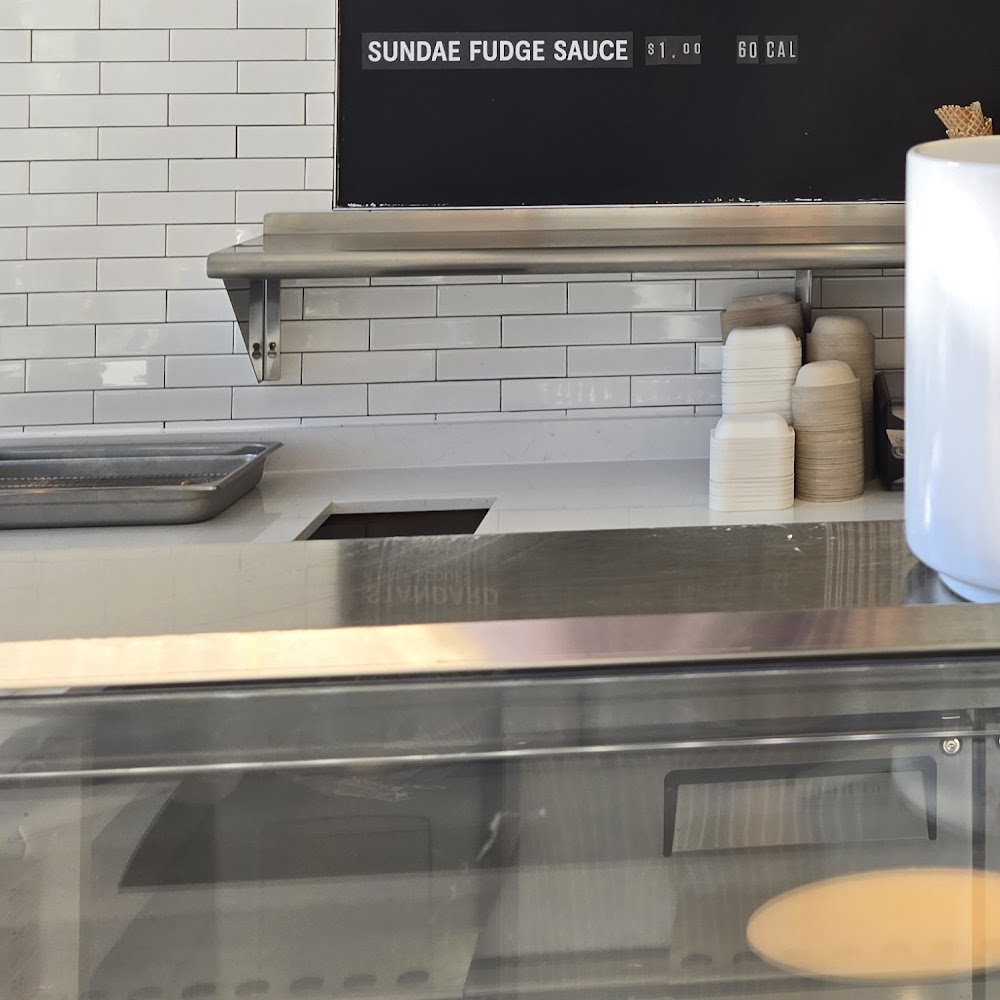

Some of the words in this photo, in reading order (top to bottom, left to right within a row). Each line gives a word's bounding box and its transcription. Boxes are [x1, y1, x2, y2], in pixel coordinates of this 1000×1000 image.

[368, 41, 460, 62] SUNDAE
[470, 41, 545, 61] FUDGE
[554, 40, 628, 60] SAUCE
[739, 41, 757, 58] 60
[767, 41, 795, 58] CAL
